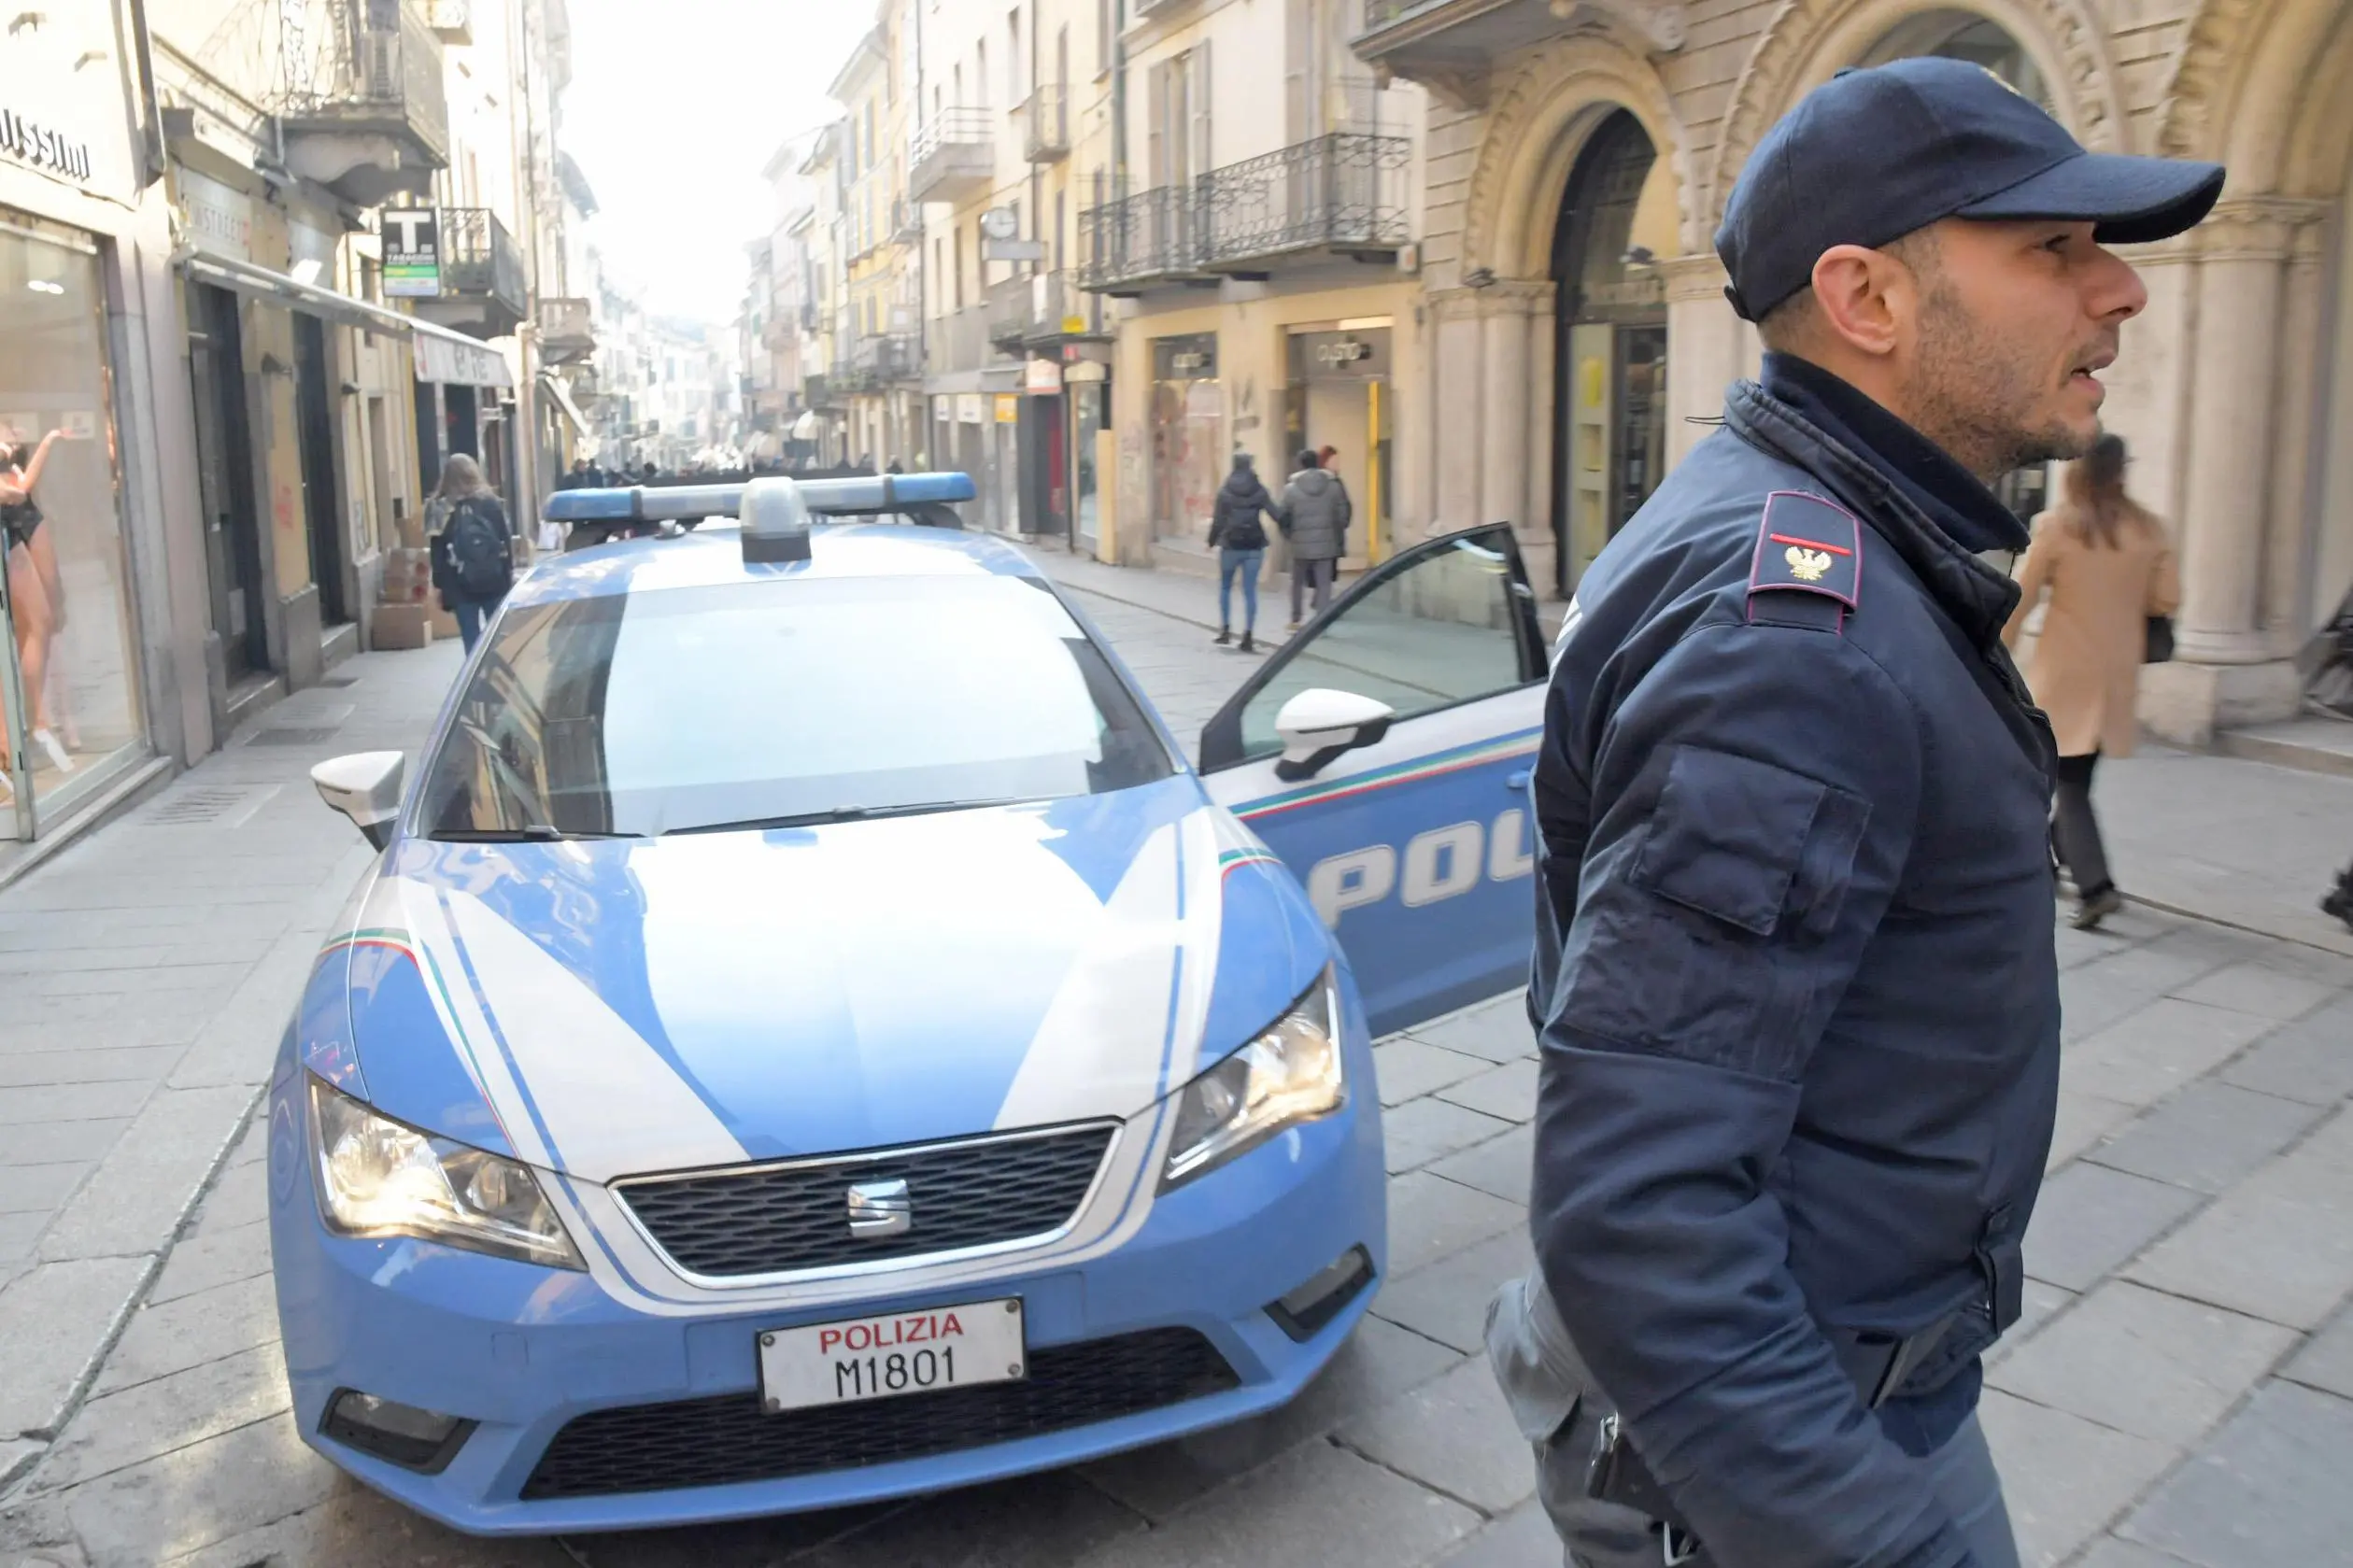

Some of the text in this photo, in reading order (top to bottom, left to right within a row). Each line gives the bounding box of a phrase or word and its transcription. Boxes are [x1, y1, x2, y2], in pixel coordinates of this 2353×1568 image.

[385, 211, 432, 254] T
[1309, 808, 1534, 929] POL
[819, 1313, 964, 1354] POLIZIA
[835, 1346, 954, 1398] M1801
